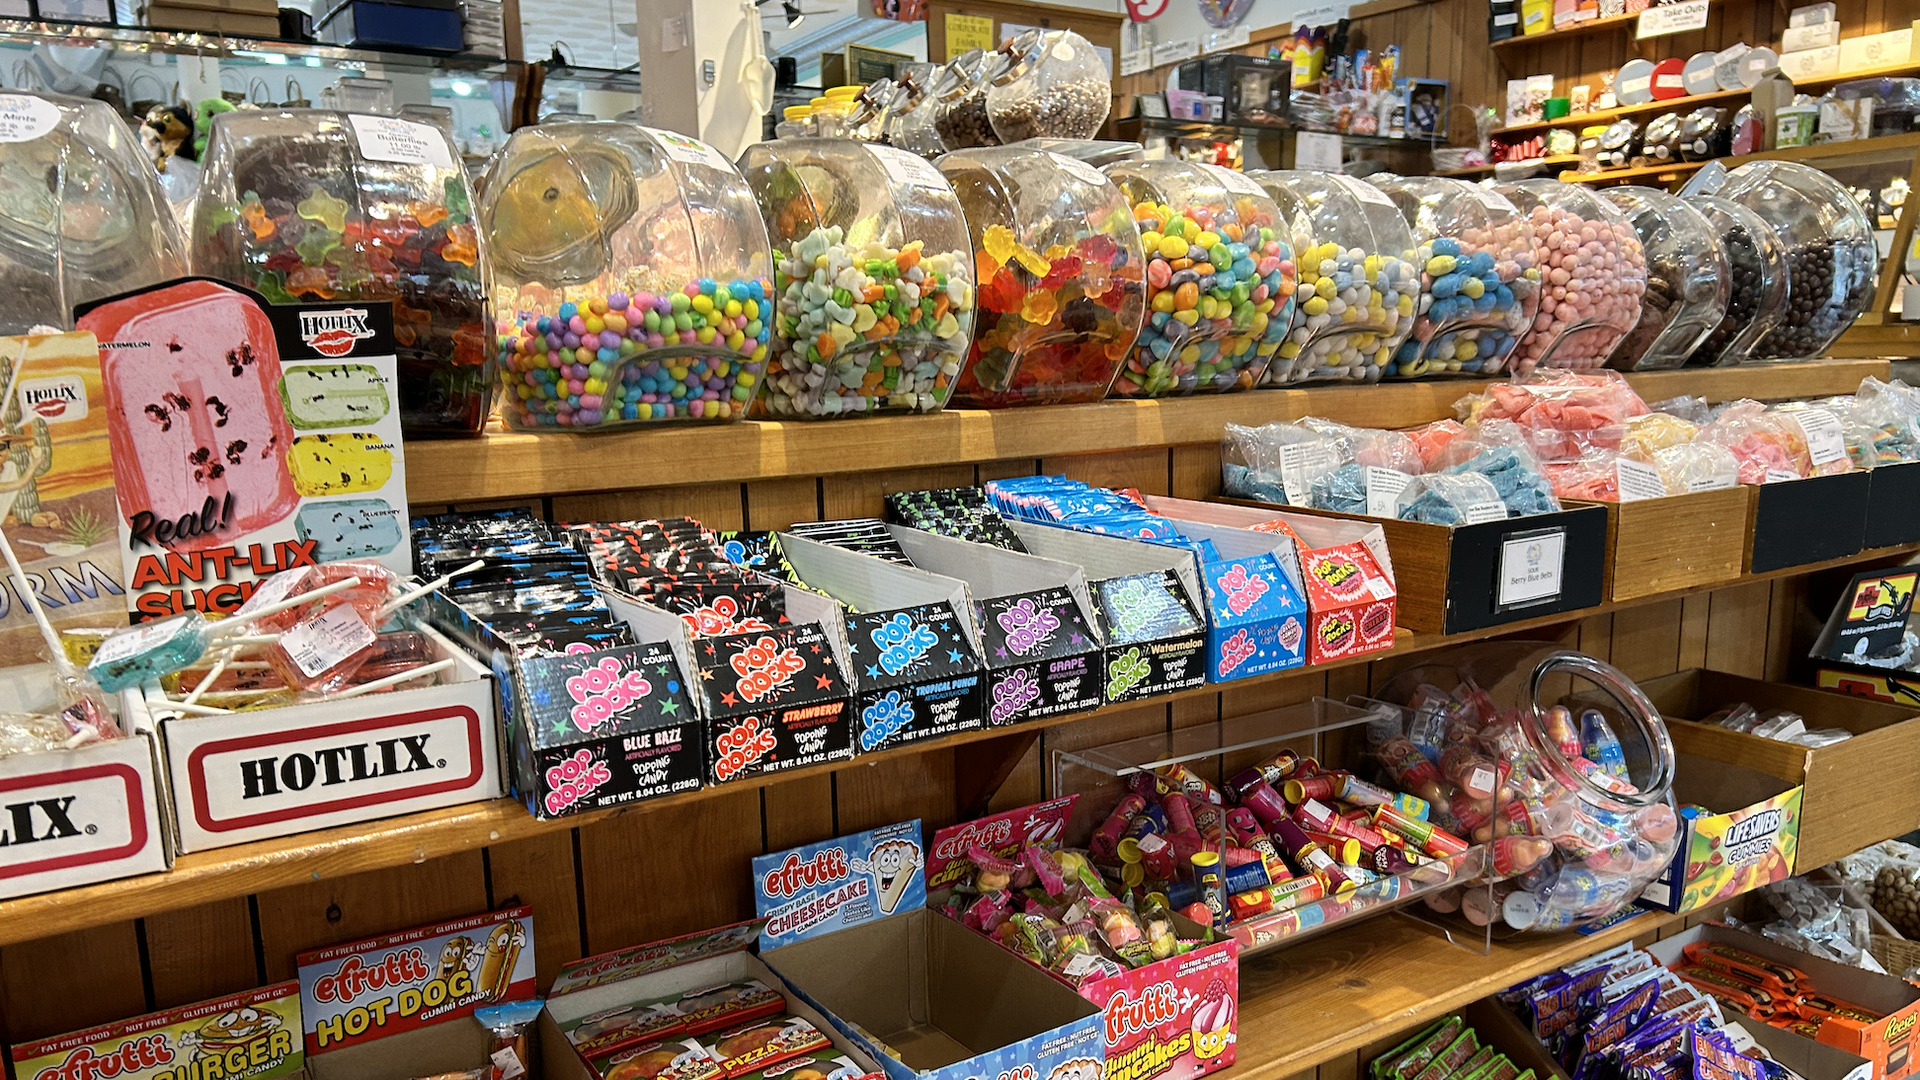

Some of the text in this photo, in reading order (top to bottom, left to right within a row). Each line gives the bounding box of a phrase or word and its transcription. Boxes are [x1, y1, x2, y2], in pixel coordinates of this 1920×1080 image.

[1663, 5, 1706, 17] Take Outs
[377, 134, 428, 146] Butterflies
[302, 310, 370, 338] HOTLIX
[367, 376, 389, 384] APPLE
[25, 385, 77, 406] HOTLIX
[365, 443, 395, 451] BANANA
[129, 491, 232, 551] Real!
[132, 539, 320, 589] ANT-LIX
[1314, 559, 1338, 578] POP
[1325, 561, 1358, 587] ROCKS
[1217, 563, 1248, 596] POP
[1511, 571, 1553, 586] Berry Blue Belts
[1049, 596, 1072, 608] COUNT
[1051, 592, 1061, 600] 24
[1110, 579, 1145, 614] POP
[1226, 572, 1270, 616] ROCKS
[928, 611, 954, 622] COUNT
[996, 597, 1036, 633] POP
[1119, 590, 1167, 635] ROCKS
[1363, 611, 1388, 632] CHERRY
[801, 628, 812, 637] 24
[871, 612, 913, 650] POP
[1005, 609, 1063, 656] ROCKS
[1321, 618, 1338, 636] POP
[1325, 621, 1353, 643] ROCKS
[797, 633, 824, 645] COUNT
[879, 623, 939, 677] ROCKS
[1151, 639, 1203, 655] Watermelon
[1221, 628, 1247, 658] POP
[641, 654, 672, 666] COUNT
[648, 648, 660, 657] 24
[729, 635, 778, 677] POP
[1108, 647, 1140, 679] POP
[1219, 638, 1256, 677] ROCKS
[736, 647, 806, 703] ROCKS
[1049, 657, 1086, 672] GRAPE
[1164, 657, 1187, 672] POPPING
[1166, 668, 1186, 681] CANDY
[1247, 665, 1258, 673] NET
[566, 657, 622, 703] POP
[916, 676, 978, 697] TROPICAL PUNCH
[992, 668, 1028, 702] POP
[1054, 676, 1081, 693] POPPING
[1107, 657, 1152, 700] ROCKS
[570, 669, 652, 734] ROCKS
[990, 678, 1040, 725] ROCKS
[1057, 688, 1079, 703] CANDY
[1139, 686, 1152, 695] NET
[782, 702, 844, 724] STRAWBERRY
[862, 690, 900, 728] POP
[930, 698, 960, 716] POPPING
[934, 710, 958, 725] CANDY
[1029, 704, 1068, 718] NET 8.04
[716, 716, 760, 756] POP
[793, 725, 828, 744] POPPING
[861, 701, 915, 751] ROCKS
[903, 725, 945, 740] NET 8.04
[623, 728, 682, 750] BLUE RAZZ
[656, 743, 682, 755] FLAVORED
[799, 739, 825, 755] CANDY
[632, 755, 671, 775] POPPING
[715, 727, 778, 782] ROCKS
[763, 752, 827, 773] NET WT. 8.04 OZ.
[239, 734, 435, 800] HOTLIX
[545, 748, 592, 789] POP
[639, 770, 669, 786] CANDY
[545, 760, 612, 816] ROCKS
[598, 778, 699, 806] NET WT. 8.04 OZ. (228G)
[936, 819, 1012, 859] efrutti
[1728, 838, 1772, 865] GUMMIES
[764, 848, 850, 898] efrutti
[494, 913, 508, 921] NOT
[766, 893, 816, 919] CRISPY BASE
[767, 880, 867, 936] CHEESECAKE
[436, 918, 483, 934] GLUTEN FREE
[797, 909, 839, 933] GUMMI CANDY
[389, 930, 424, 944] NUT FREE
[320, 940, 377, 959] FAT FREE FOOD
[1188, 959, 1201, 968] FREE
[1215, 950, 1227, 959] FREE
[314, 946, 430, 1004] efrutti
[559, 955, 678, 995] PIZZA
[1176, 968, 1194, 978] GLUTEN
[1195, 964, 1208, 972] FREE
[253, 992, 271, 1002] NOT
[316, 969, 473, 1048] HOT DOG
[420, 989, 491, 1022] GUMMI CANDY
[1537, 995, 1559, 1018] BIG
[1609, 984, 1655, 1024] LEAGUE
[183, 999, 240, 1019] GLUTEN FREE
[683, 1001, 739, 1023] PIZZA
[1104, 981, 1179, 1047] frutti
[125, 1016, 168, 1033] NUT FREE
[1589, 1019, 1627, 1053] CHEW
[1883, 1010, 1918, 1042] Reese's
[41, 1030, 110, 1053] FAT FREE FOOD
[577, 1029, 637, 1052] PIZZA
[1037, 1037, 1089, 1060] GLUTEN FREE NOT
[1041, 1026, 1096, 1051] FAT FREE NUT FREE
[247, 1057, 284, 1077] CANDY
[723, 1042, 780, 1072] PIZZA
[1105, 1033, 1155, 1078] gummi
